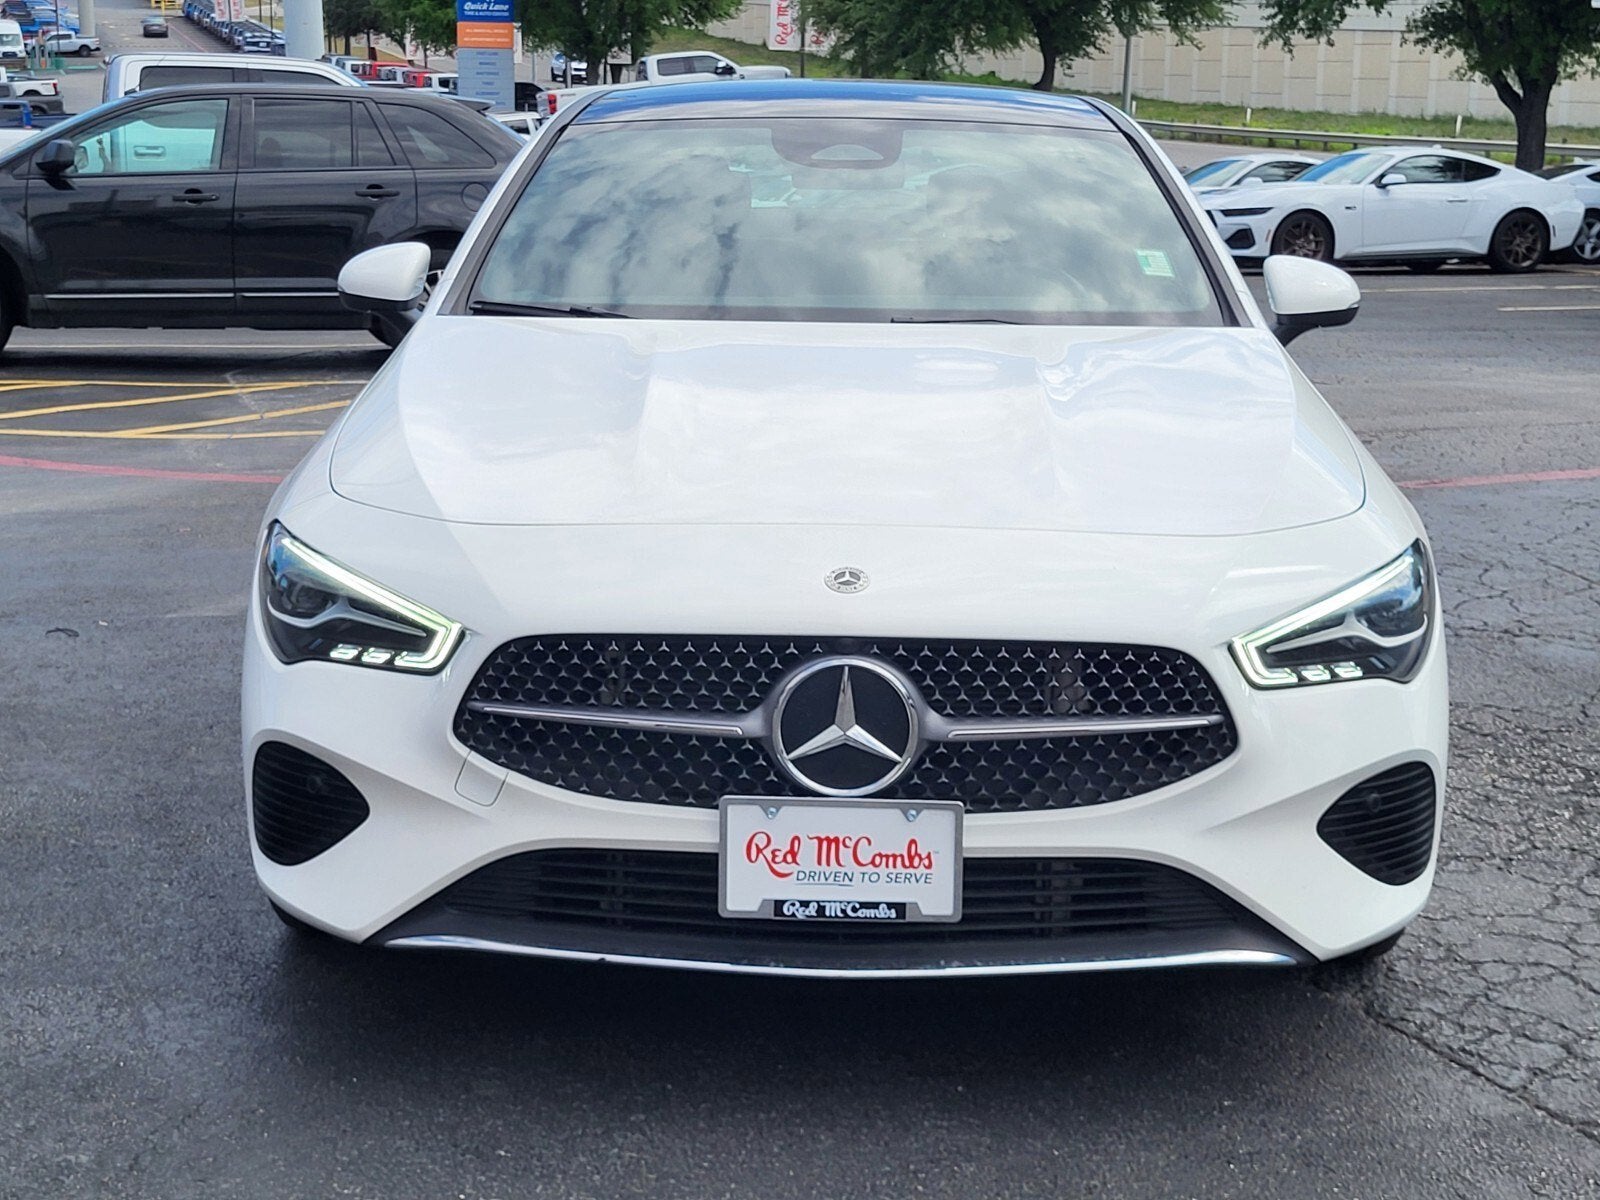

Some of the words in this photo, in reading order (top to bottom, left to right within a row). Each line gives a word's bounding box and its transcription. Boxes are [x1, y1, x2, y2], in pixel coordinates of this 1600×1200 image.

[463, 2, 488, 10] Quick
[775, 22, 793, 45] Red
[746, 831, 801, 878] Red
[807, 834, 933, 869] McCombs
[796, 870, 854, 883] DRIVEN
[860, 871, 881, 883] TO
[885, 872, 933, 884] SERVE
[782, 900, 819, 919] Red
[820, 901, 897, 919] McCombs
